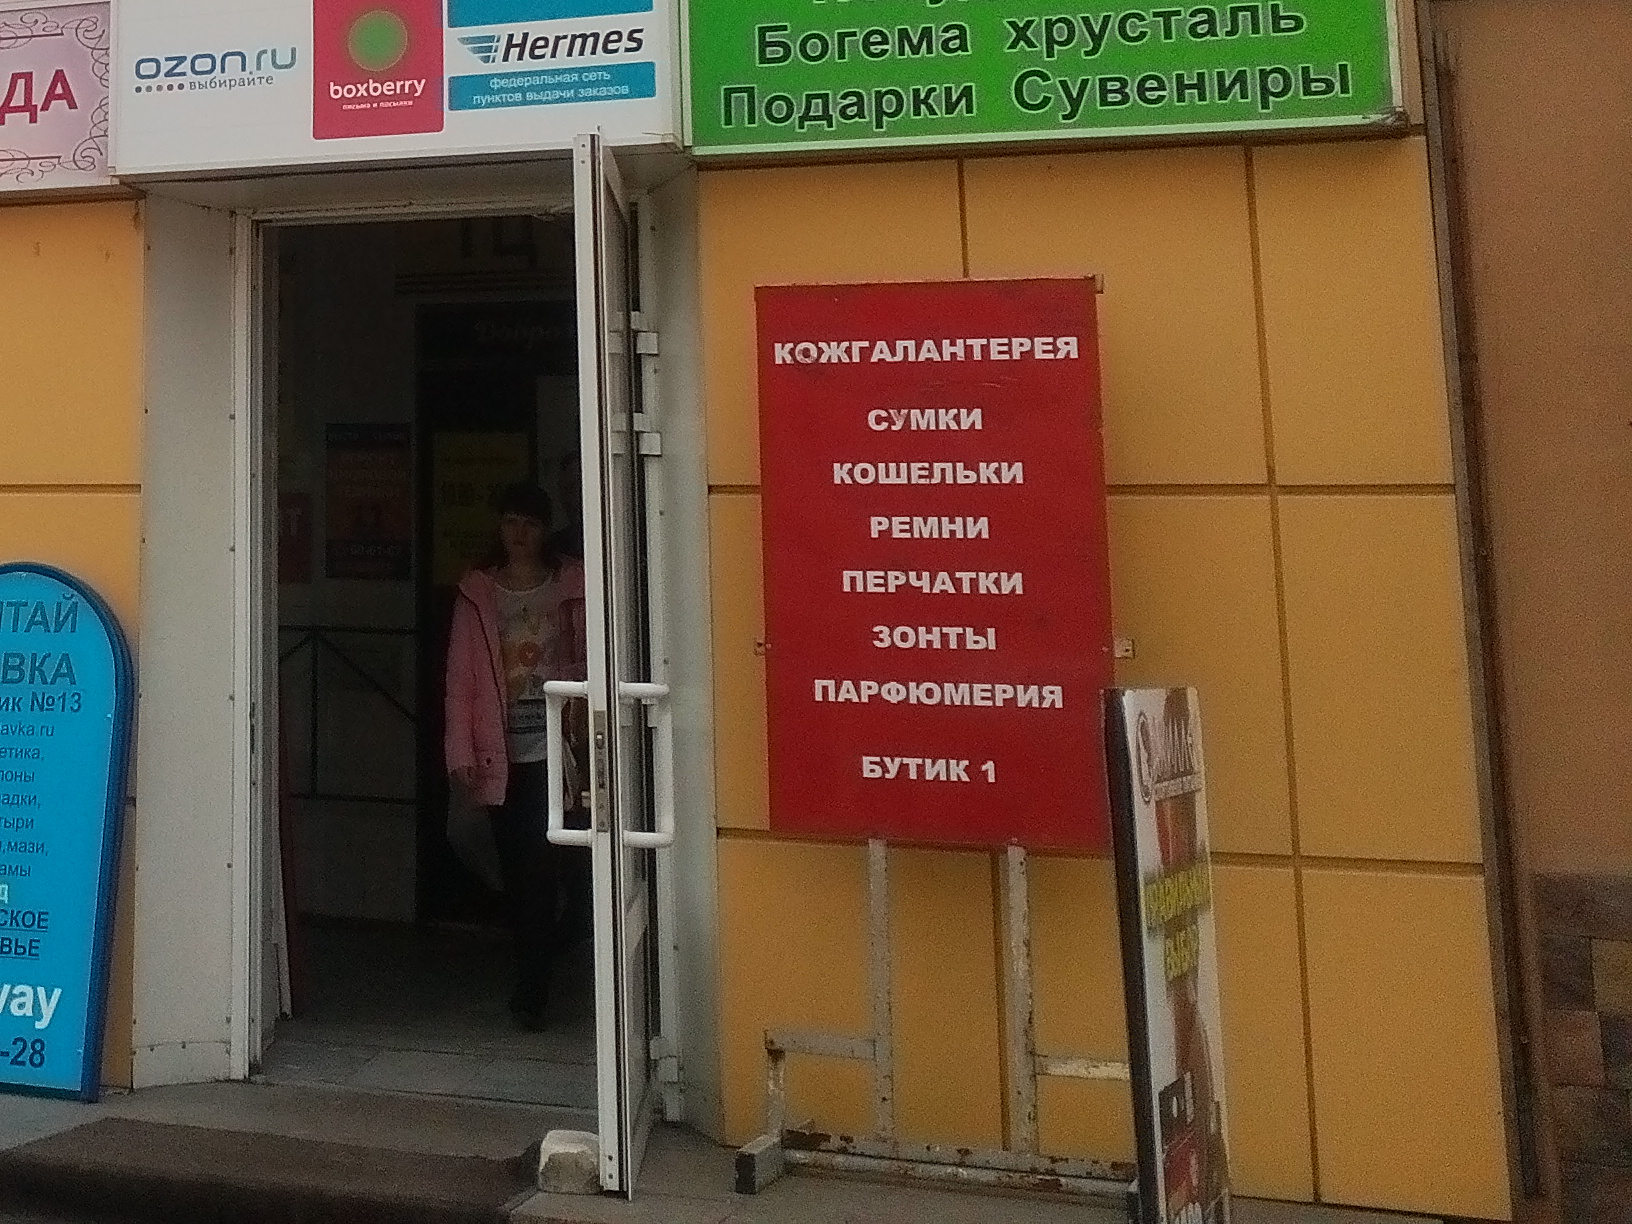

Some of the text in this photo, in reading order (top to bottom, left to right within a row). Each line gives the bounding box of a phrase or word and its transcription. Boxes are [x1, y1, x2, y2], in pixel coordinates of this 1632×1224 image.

[501, 26, 645, 63] Hermes
[755, 0, 1307, 68] Богема хрусталь
[135, 46, 297, 80] ozon.ru
[329, 78, 426, 99] boxberry
[489, 70, 611, 91] федеральная сеть
[472, 84, 629, 107] пунктов выдачи заказов
[721, 59, 1354, 132] Подарки Сувениры
[774, 336, 1079, 365] КОЖГАЛАНТЕРЕЯ
[868, 408, 984, 431] СУМКИ
[832, 461, 1025, 485] КОШЕЛЬКИ
[869, 516, 990, 540] РЕМНИ
[842, 570, 1024, 595] ПЕРЧАТКИ
[872, 626, 997, 650] ЗОНТЫ
[30, 692, 82, 712] №13
[814, 679, 1064, 709] ПАРФЮМЕРИЯ
[862, 756, 997, 783] БУТИК 1
